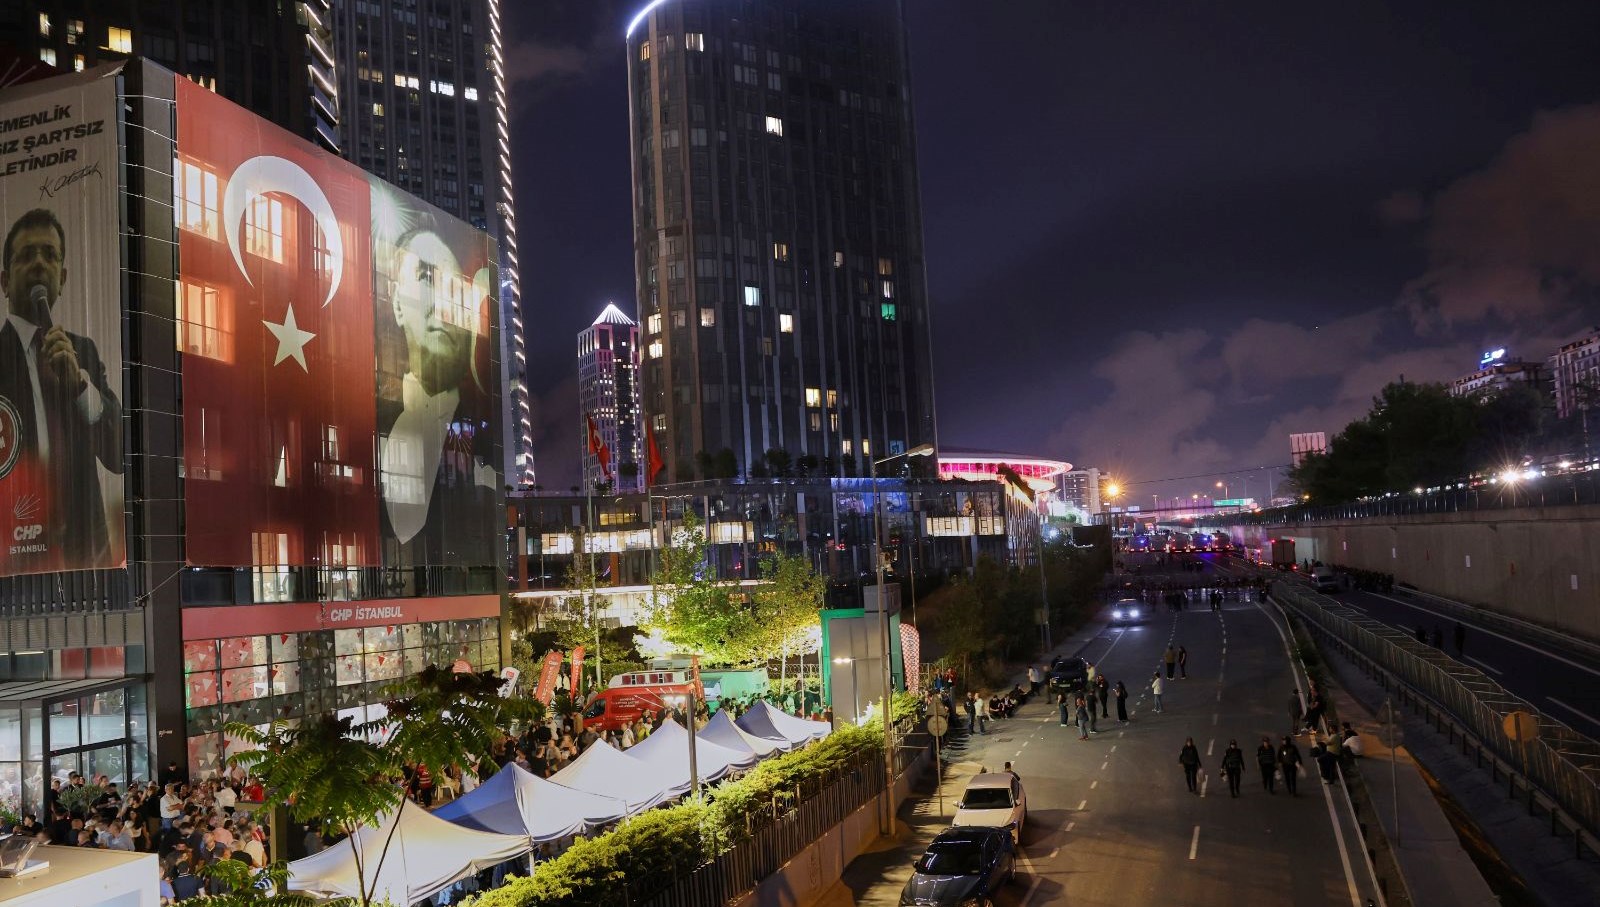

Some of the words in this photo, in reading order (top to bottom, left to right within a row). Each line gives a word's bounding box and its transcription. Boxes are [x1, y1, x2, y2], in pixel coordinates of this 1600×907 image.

[0, 140, 19, 155] IZ
[23, 120, 104, 153] ŞARTSIZ
[13, 524, 42, 540] CHP
[9, 544, 47, 555] İSTANBUL
[331, 609, 352, 621] CHP
[355, 606, 403, 620] İSTANBUL
